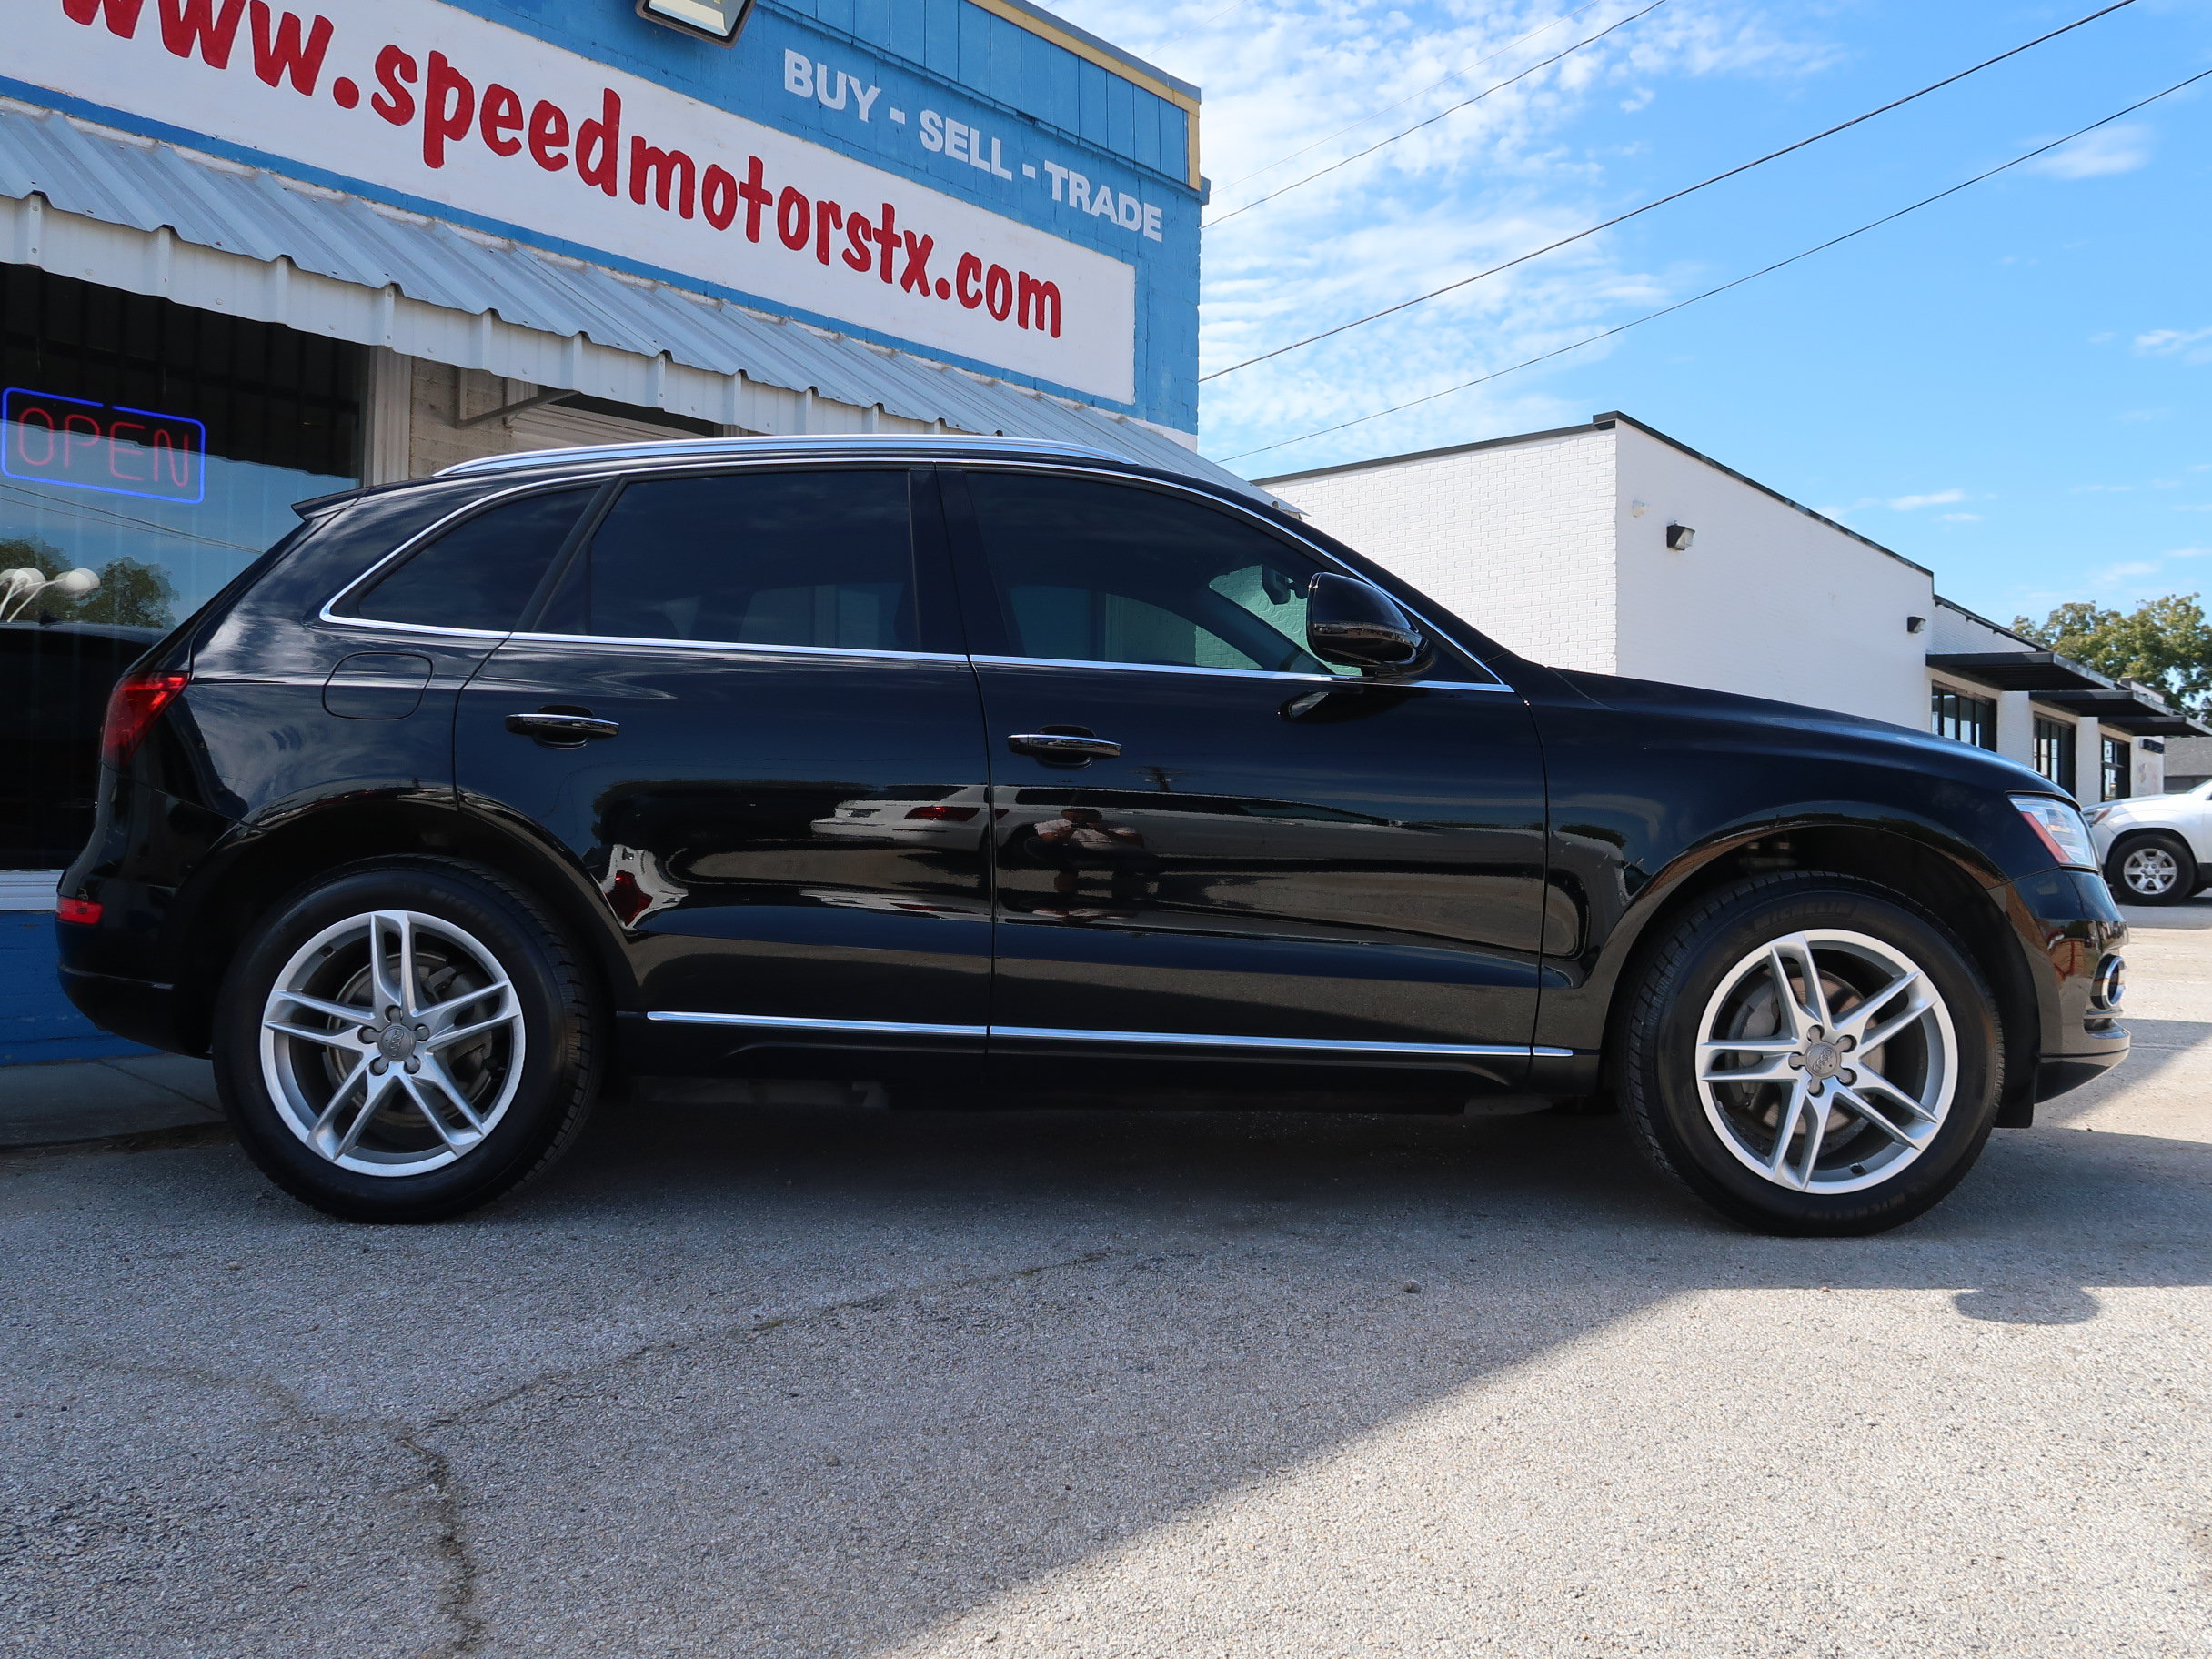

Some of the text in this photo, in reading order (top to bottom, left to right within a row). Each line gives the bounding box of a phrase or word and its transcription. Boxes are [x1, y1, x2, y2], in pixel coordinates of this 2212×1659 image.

[783, 48, 881, 124] BUY
[919, 110, 1013, 181] SELL
[1044, 159, 1162, 243] TRADE
[18, 407, 189, 487] OPEN
